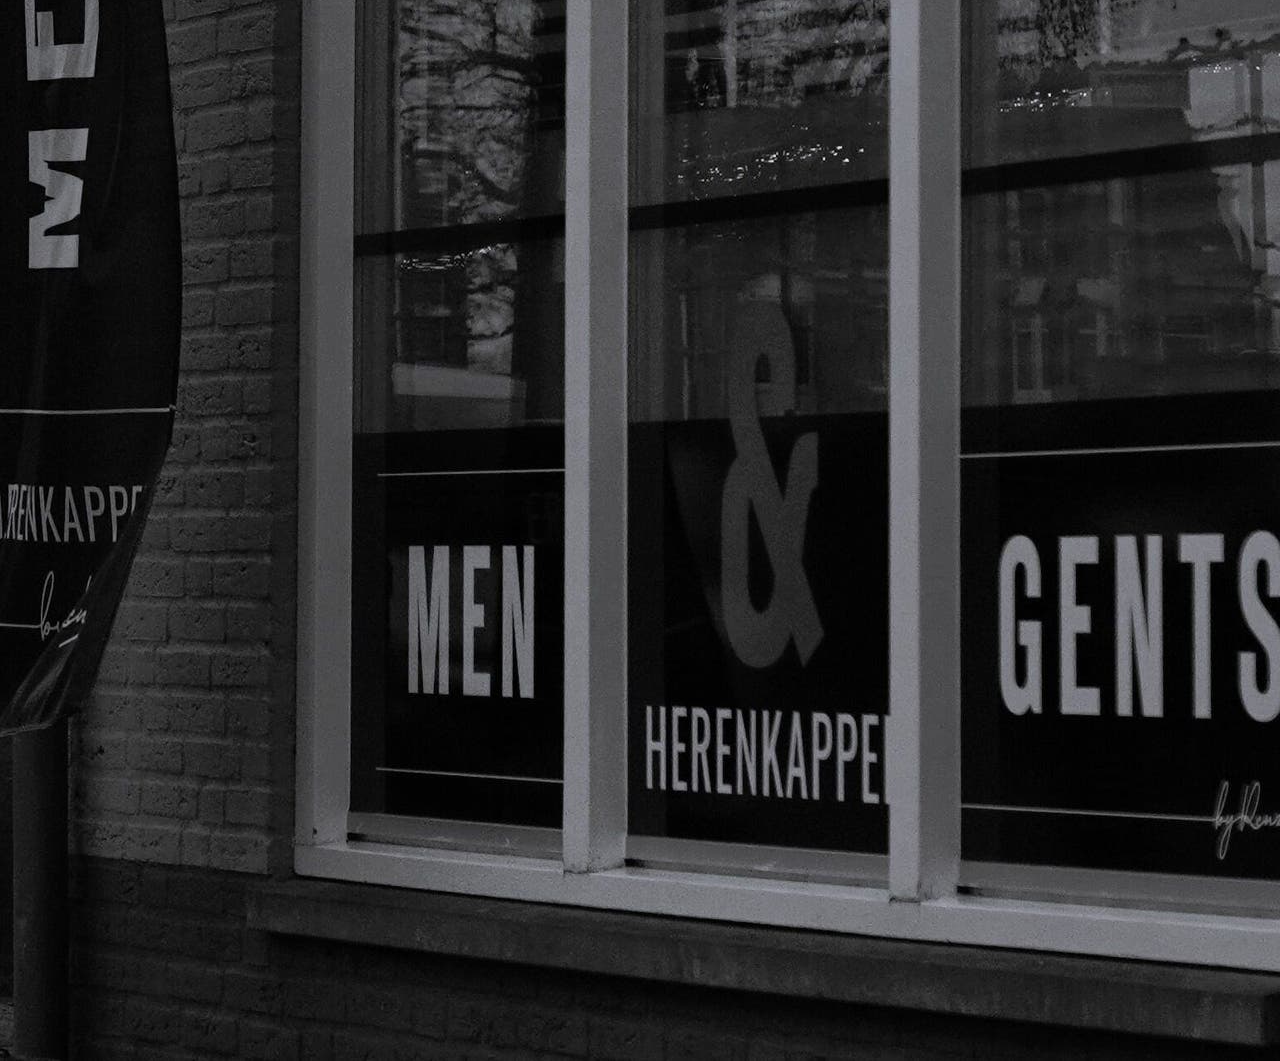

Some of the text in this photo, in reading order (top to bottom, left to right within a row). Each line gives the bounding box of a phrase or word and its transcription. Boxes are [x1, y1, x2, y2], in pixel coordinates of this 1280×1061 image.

[407, 544, 536, 699] MEN
[720, 273, 825, 670] &
[644, 704, 890, 806] HERENKAPPE
